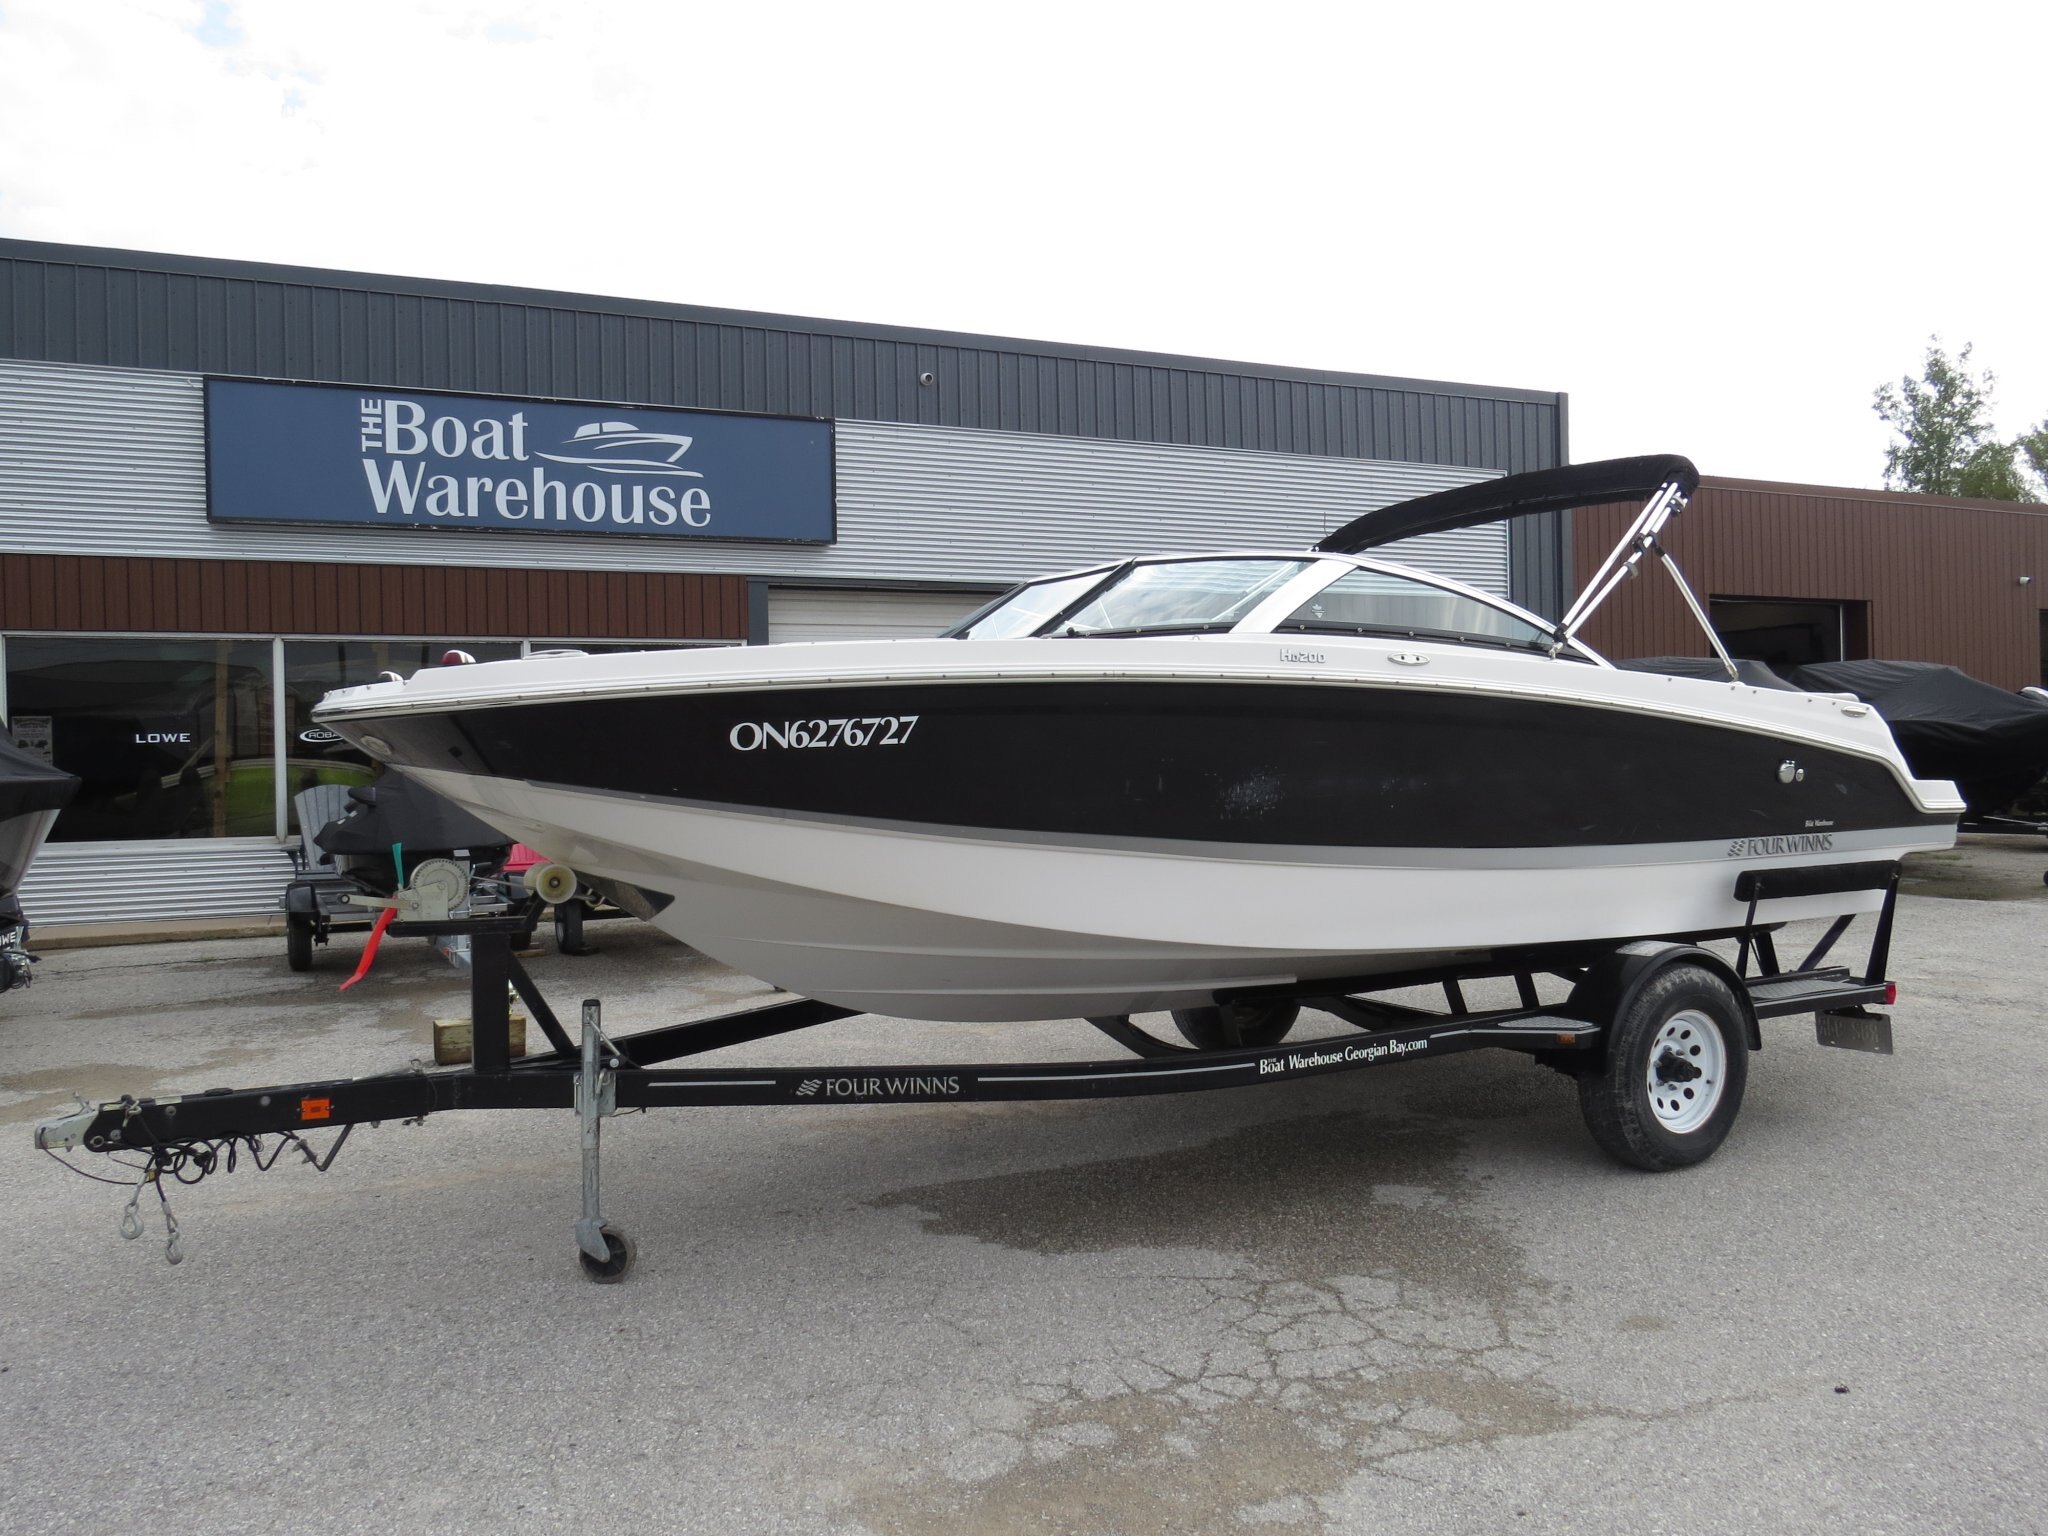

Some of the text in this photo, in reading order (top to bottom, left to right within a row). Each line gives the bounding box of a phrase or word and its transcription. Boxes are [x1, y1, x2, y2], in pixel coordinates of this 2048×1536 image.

[360, 398, 382, 452] THE
[385, 399, 529, 461] Boat
[362, 458, 712, 528] Warehouse
[135, 733, 191, 743] LOWE
[729, 715, 920, 751] ON6276727
[1747, 833, 1833, 856] FOUR WINNS
[1259, 1039, 1428, 1075] Boat Warehouse Georgian Bay.com
[826, 1076, 960, 1096] FOUR WINNS
